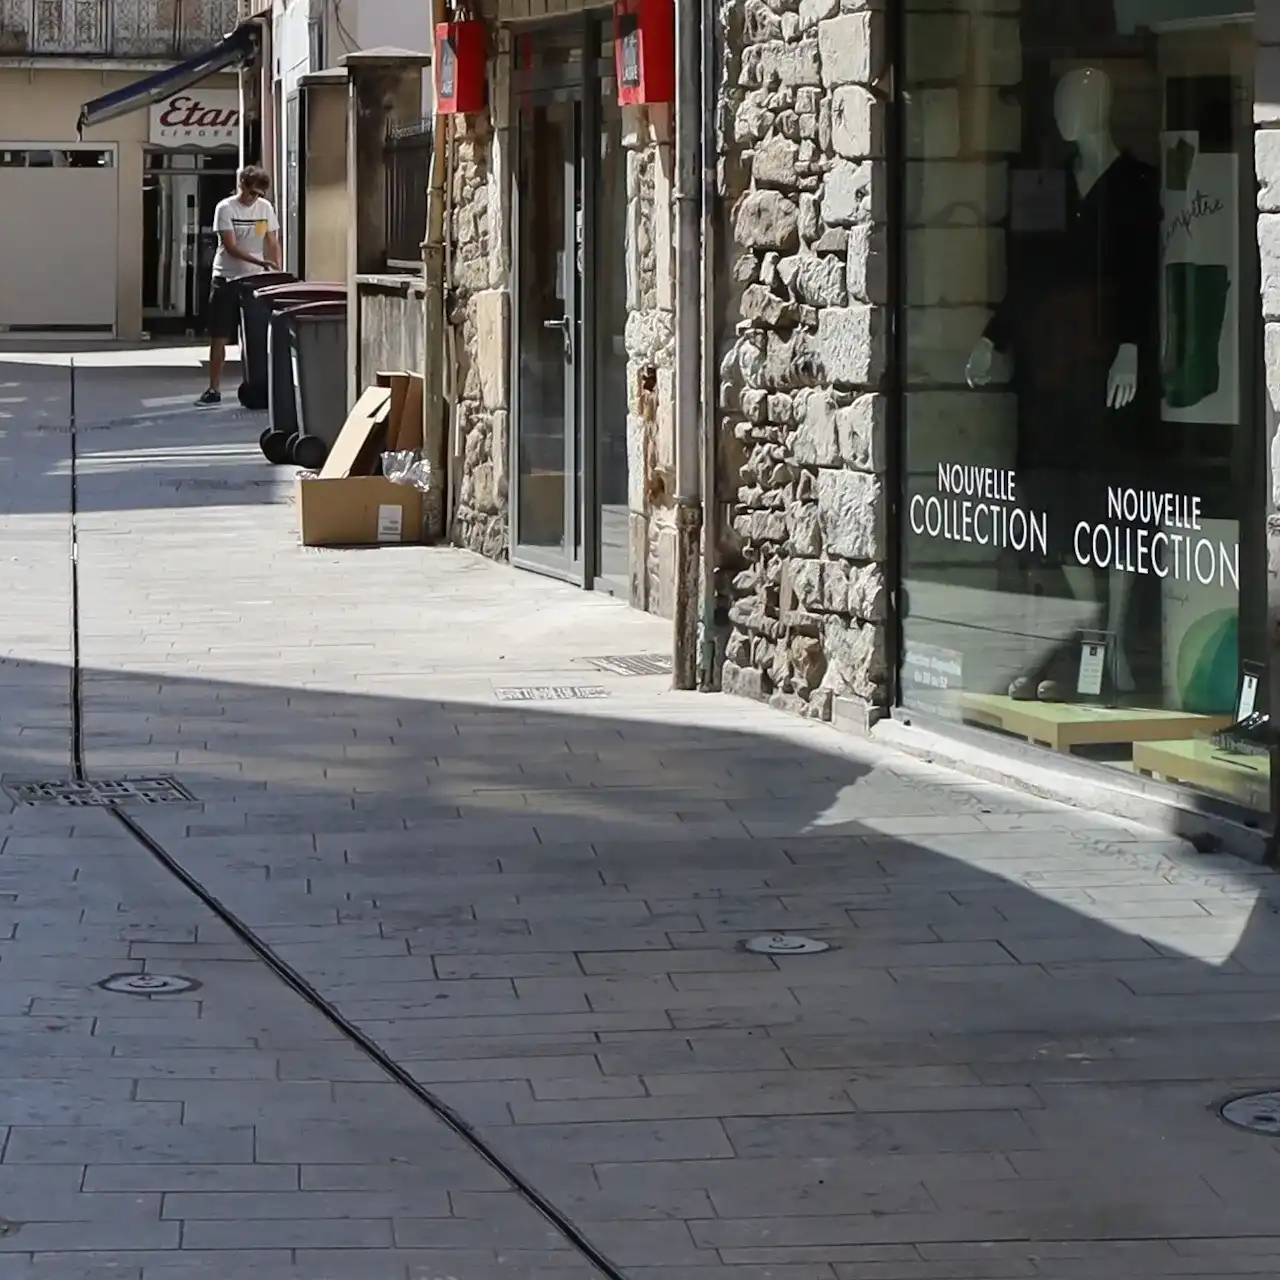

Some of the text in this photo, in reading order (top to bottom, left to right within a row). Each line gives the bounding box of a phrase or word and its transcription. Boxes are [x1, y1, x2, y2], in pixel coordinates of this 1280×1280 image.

[938, 462, 1016, 502] NOUVELLE
[1108, 486, 1202, 531] NOUVELLE
[910, 494, 1048, 556] COLLECTION
[1074, 520, 1240, 592] COLLECTION
